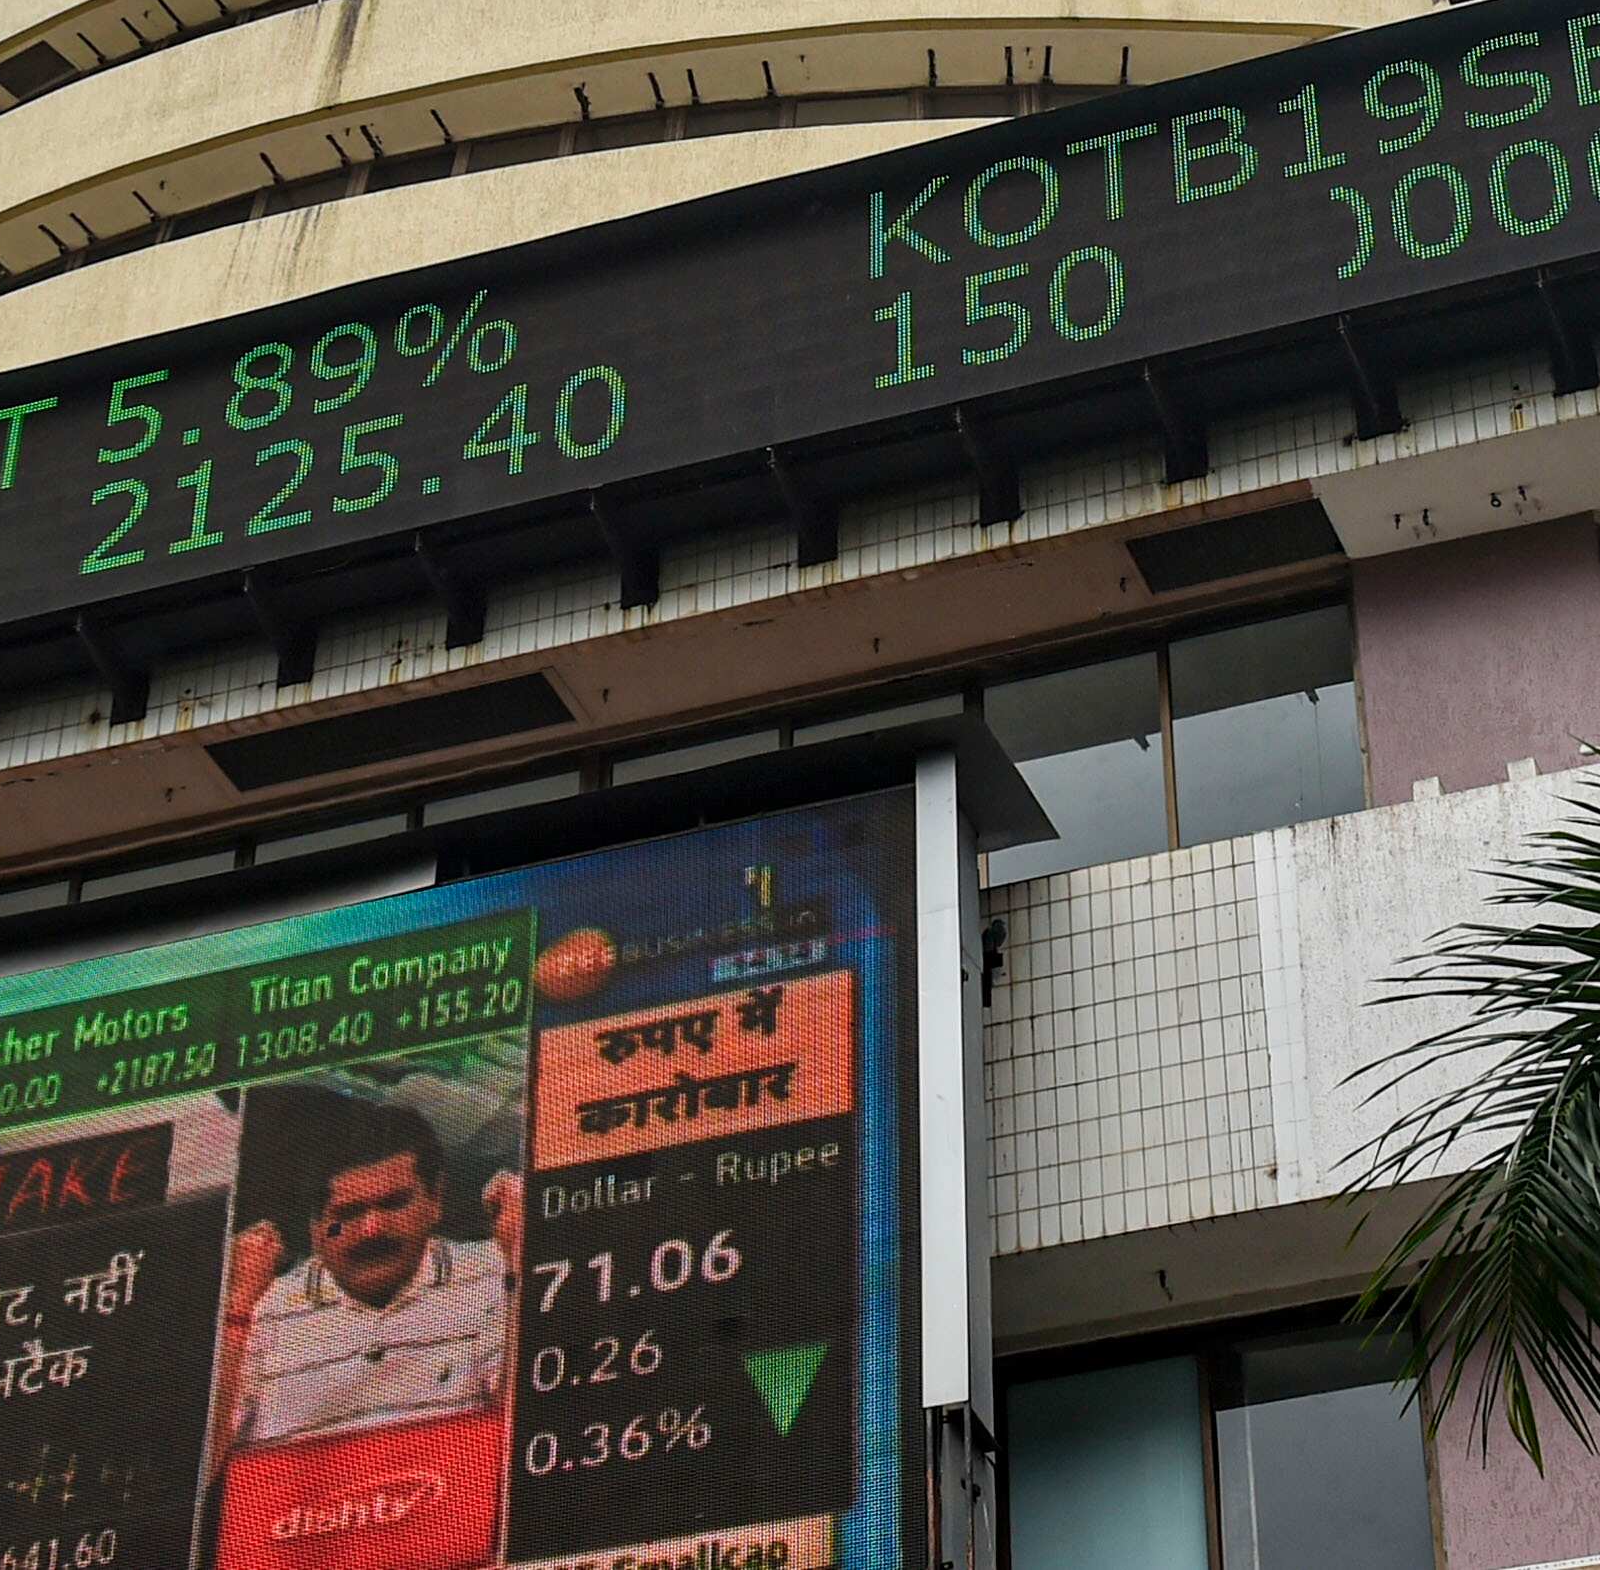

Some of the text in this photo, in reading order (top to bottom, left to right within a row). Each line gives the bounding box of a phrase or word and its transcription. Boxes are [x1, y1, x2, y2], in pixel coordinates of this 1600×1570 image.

[96, 289, 518, 465] 5.89%
[77, 364, 629, 575] 2125.40
[73, 1003, 190, 1052] Motors
[250, 973, 333, 1015] Titan
[349, 936, 512, 995] Company
[236, 1010, 375, 1068] 1308.40
[398, 979, 523, 1031] +155.20
[542, 1174, 655, 1220] Dollar
[716, 1142, 840, 1188] Rupee
[64, 1248, 146, 1316] नहीं
[532, 1229, 744, 1314] 71.06
[532, 1329, 664, 1392] 0.26
[525, 1403, 712, 1476] 0.36%
